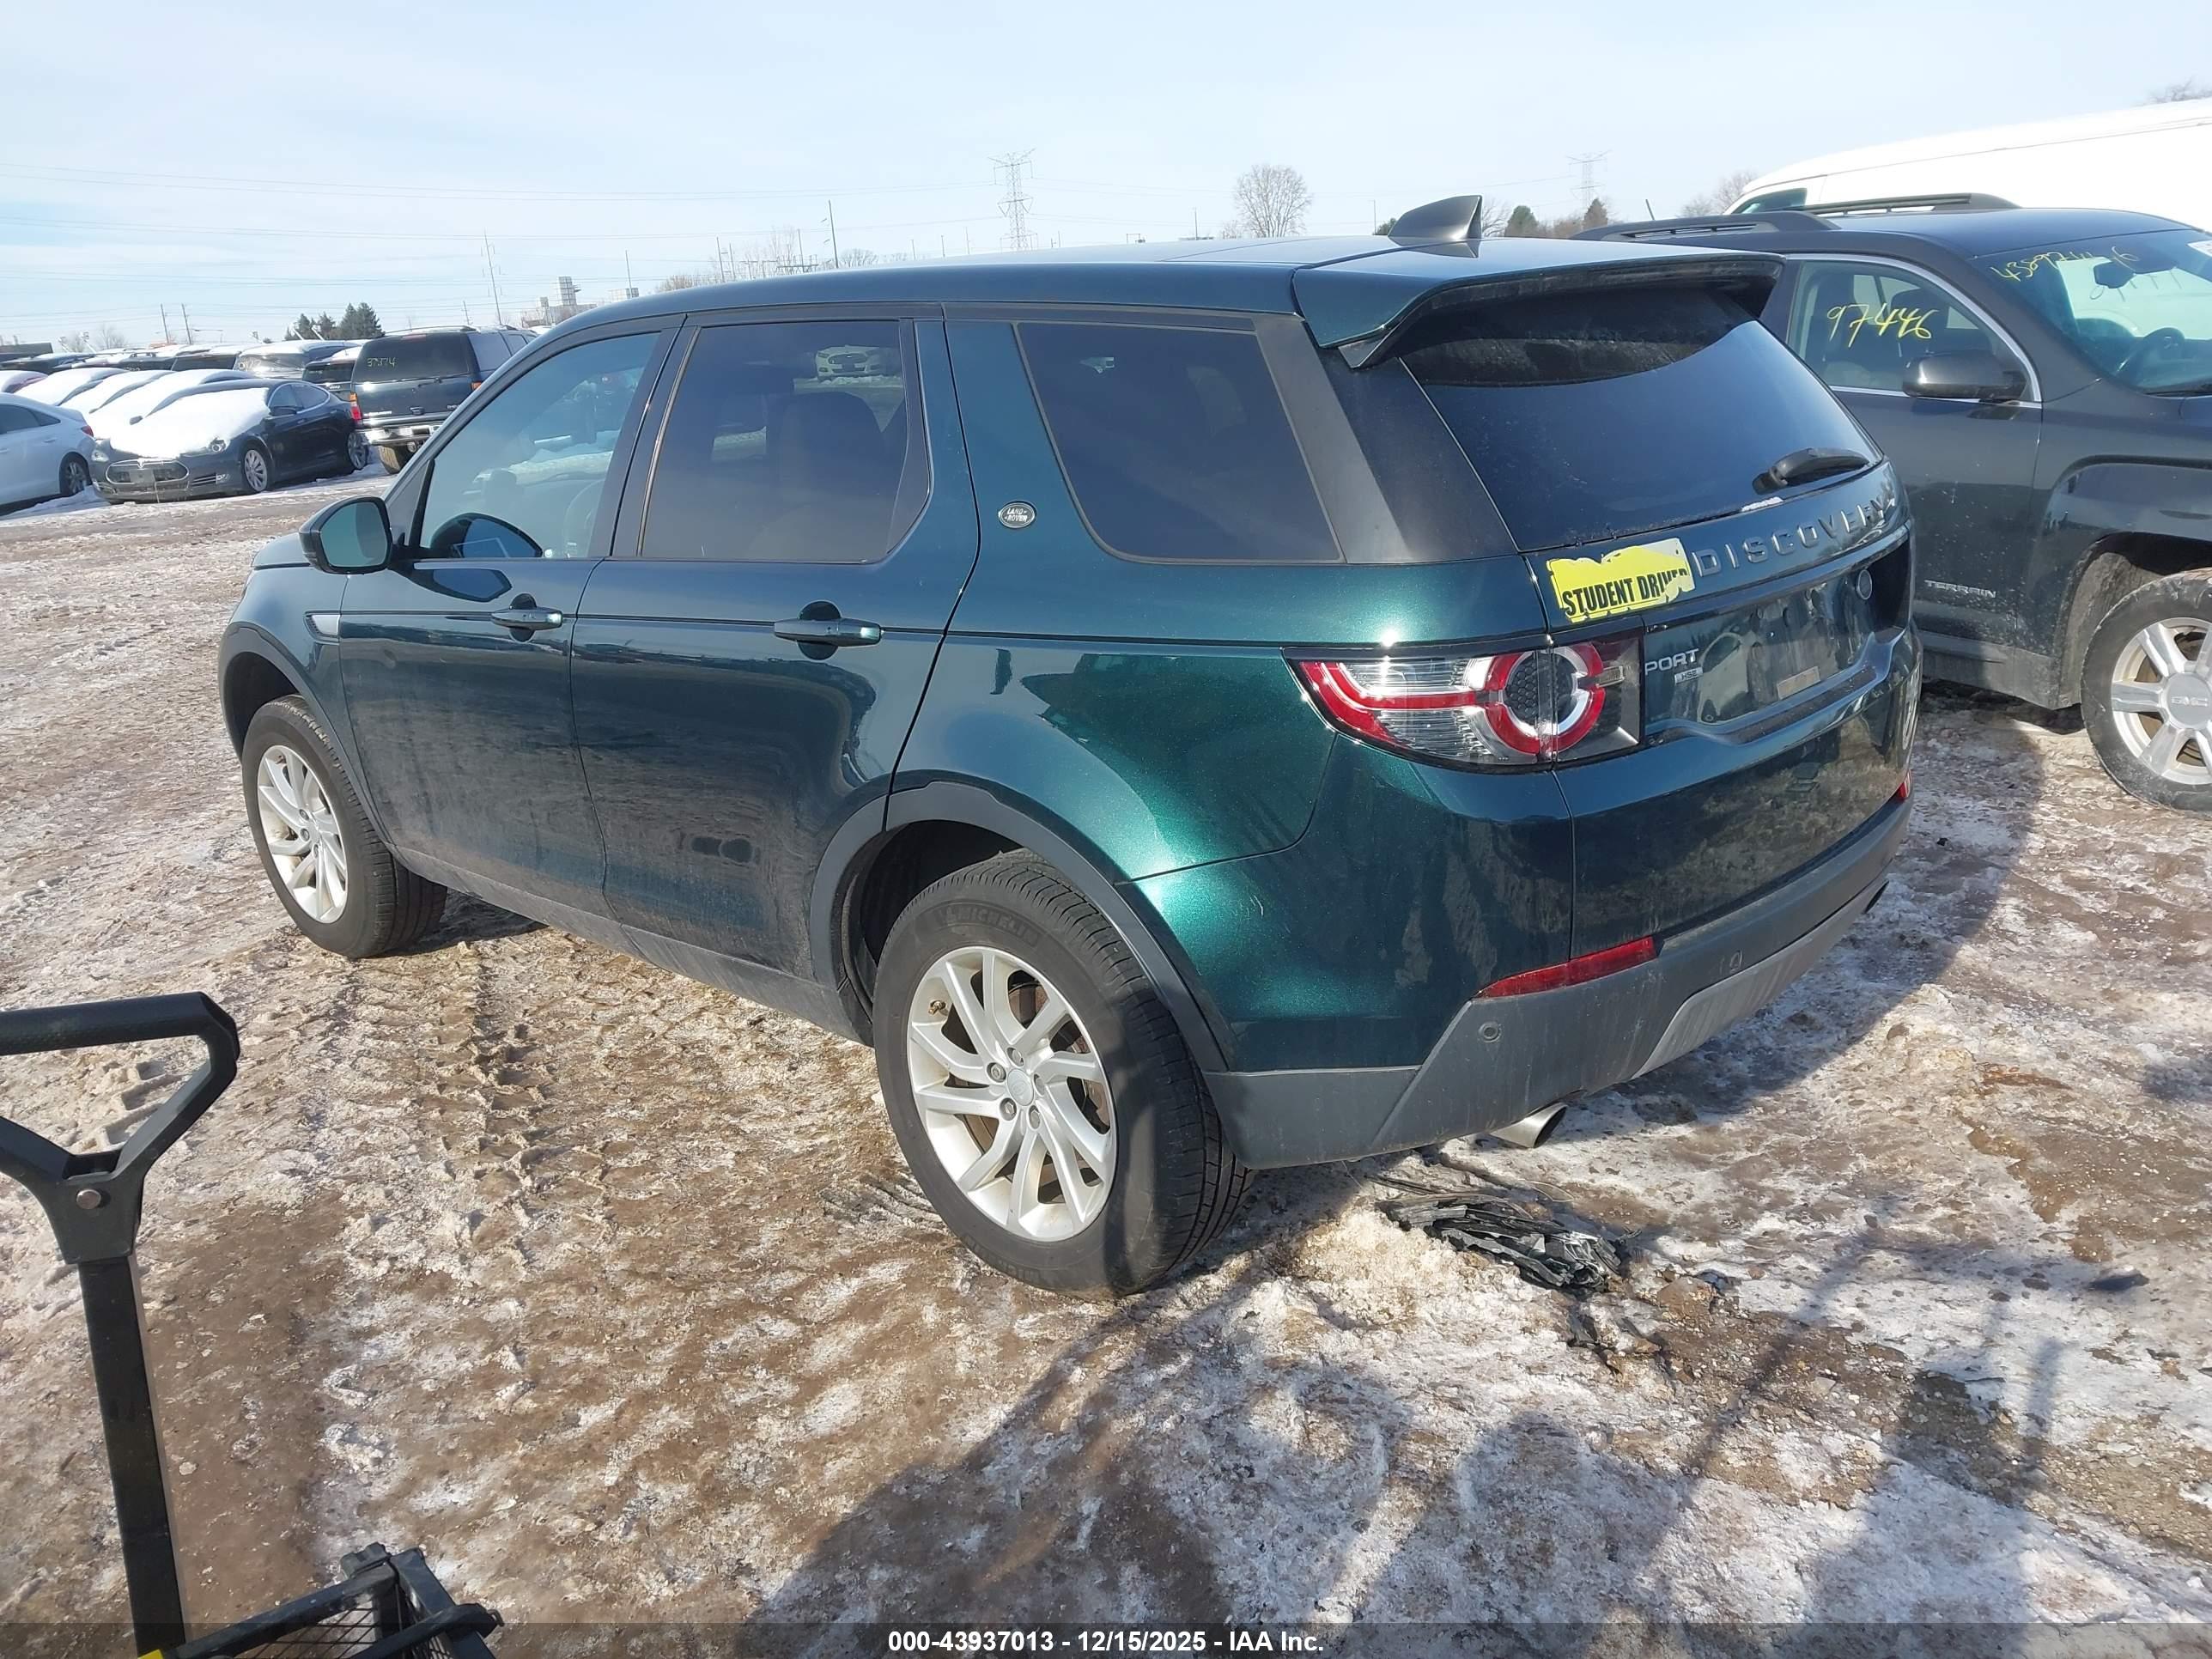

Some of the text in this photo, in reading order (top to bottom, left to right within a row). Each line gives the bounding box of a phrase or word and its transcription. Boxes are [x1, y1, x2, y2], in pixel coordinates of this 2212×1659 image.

[1826, 303, 1940, 348] 97446
[1692, 498, 1895, 577] DISCOVERY
[1562, 577, 1633, 617] STUDENT
[1923, 580, 1996, 599] TERRAIN
[1644, 647, 1699, 676] PORT
[1680, 669, 1698, 680] HSE
